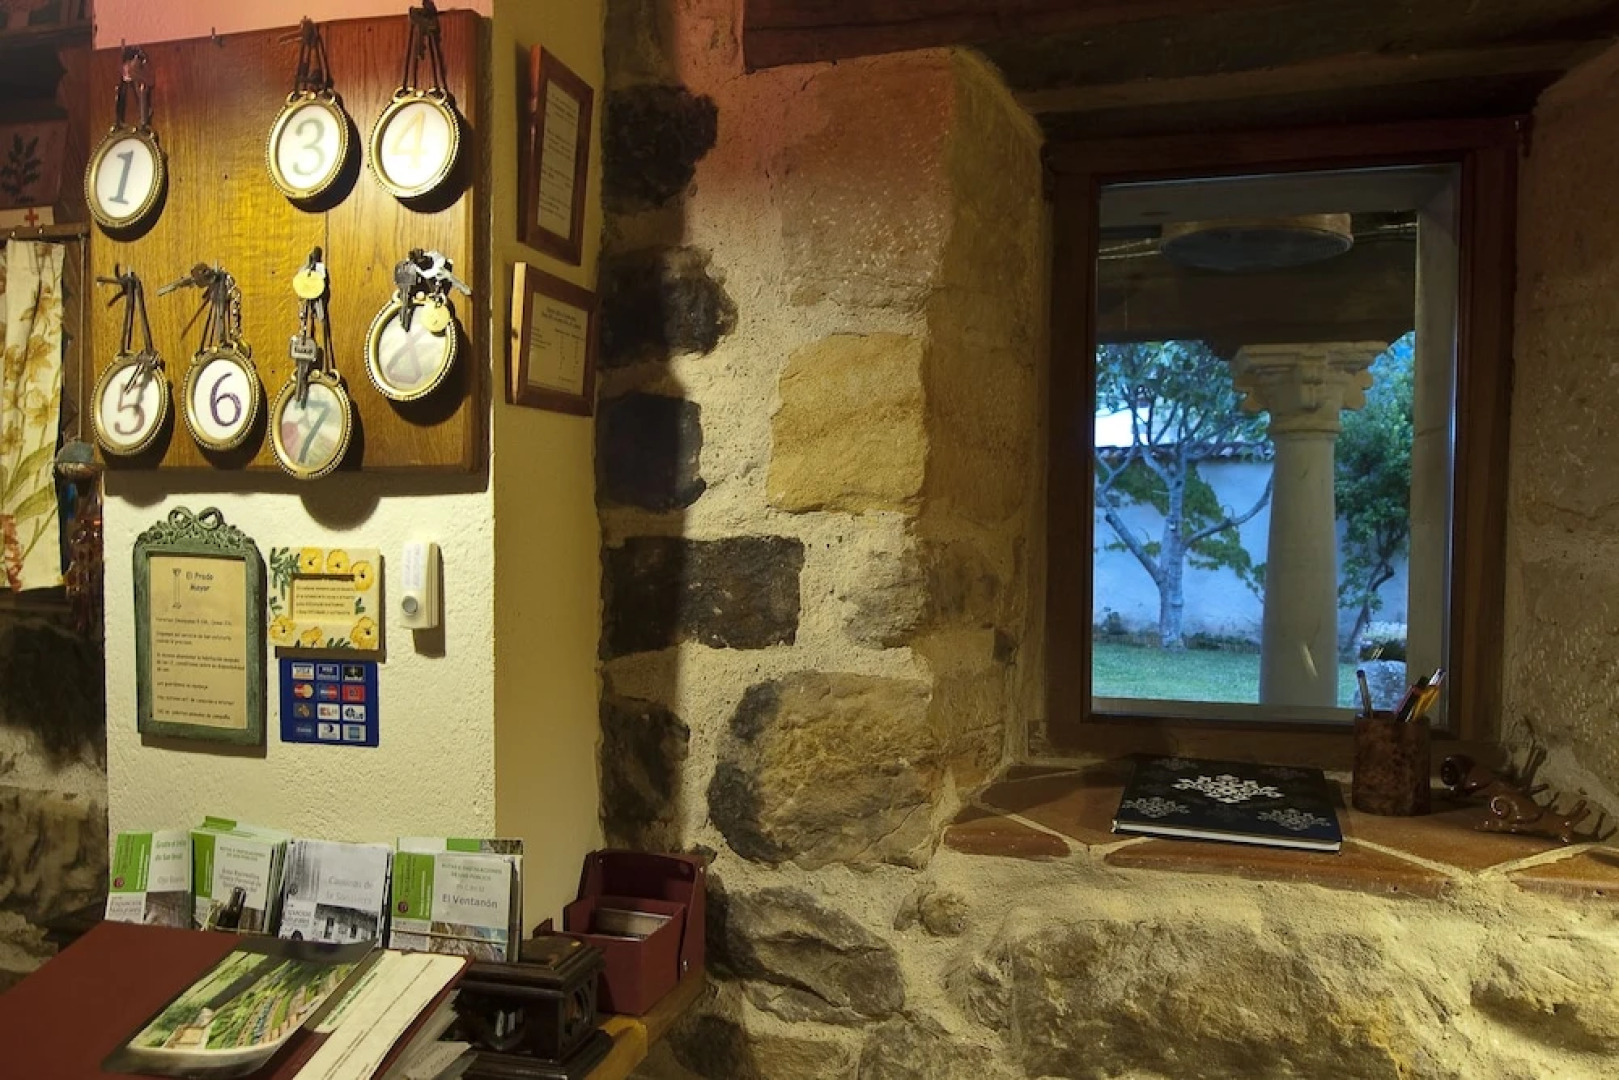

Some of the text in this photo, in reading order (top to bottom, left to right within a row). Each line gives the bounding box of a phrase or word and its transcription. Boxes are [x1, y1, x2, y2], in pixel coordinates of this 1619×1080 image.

[292, 117, 326, 176] 3
[391, 110, 430, 169] 4
[108, 150, 134, 205] 1
[114, 382, 146, 436] 5
[210, 371, 242, 427] 6
[295, 400, 330, 464] 7
[441, 893, 498, 910] El Ventanón
